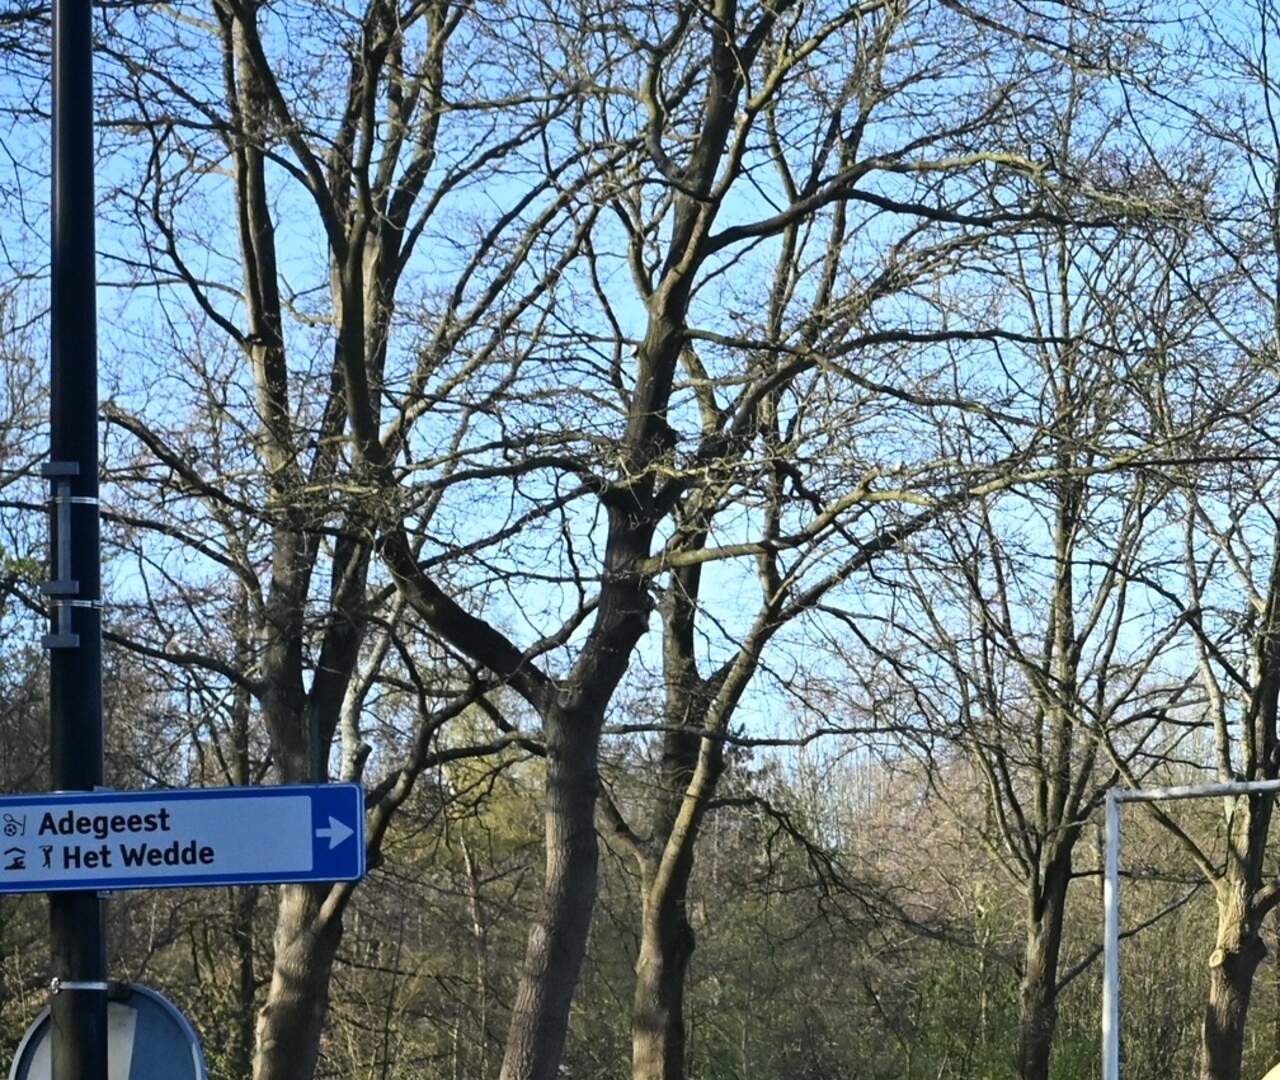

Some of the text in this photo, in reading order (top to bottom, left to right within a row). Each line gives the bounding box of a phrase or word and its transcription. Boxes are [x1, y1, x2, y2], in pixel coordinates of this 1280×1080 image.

[38, 808, 171, 839] Adegeest
[62, 841, 215, 870] Het Wedde
